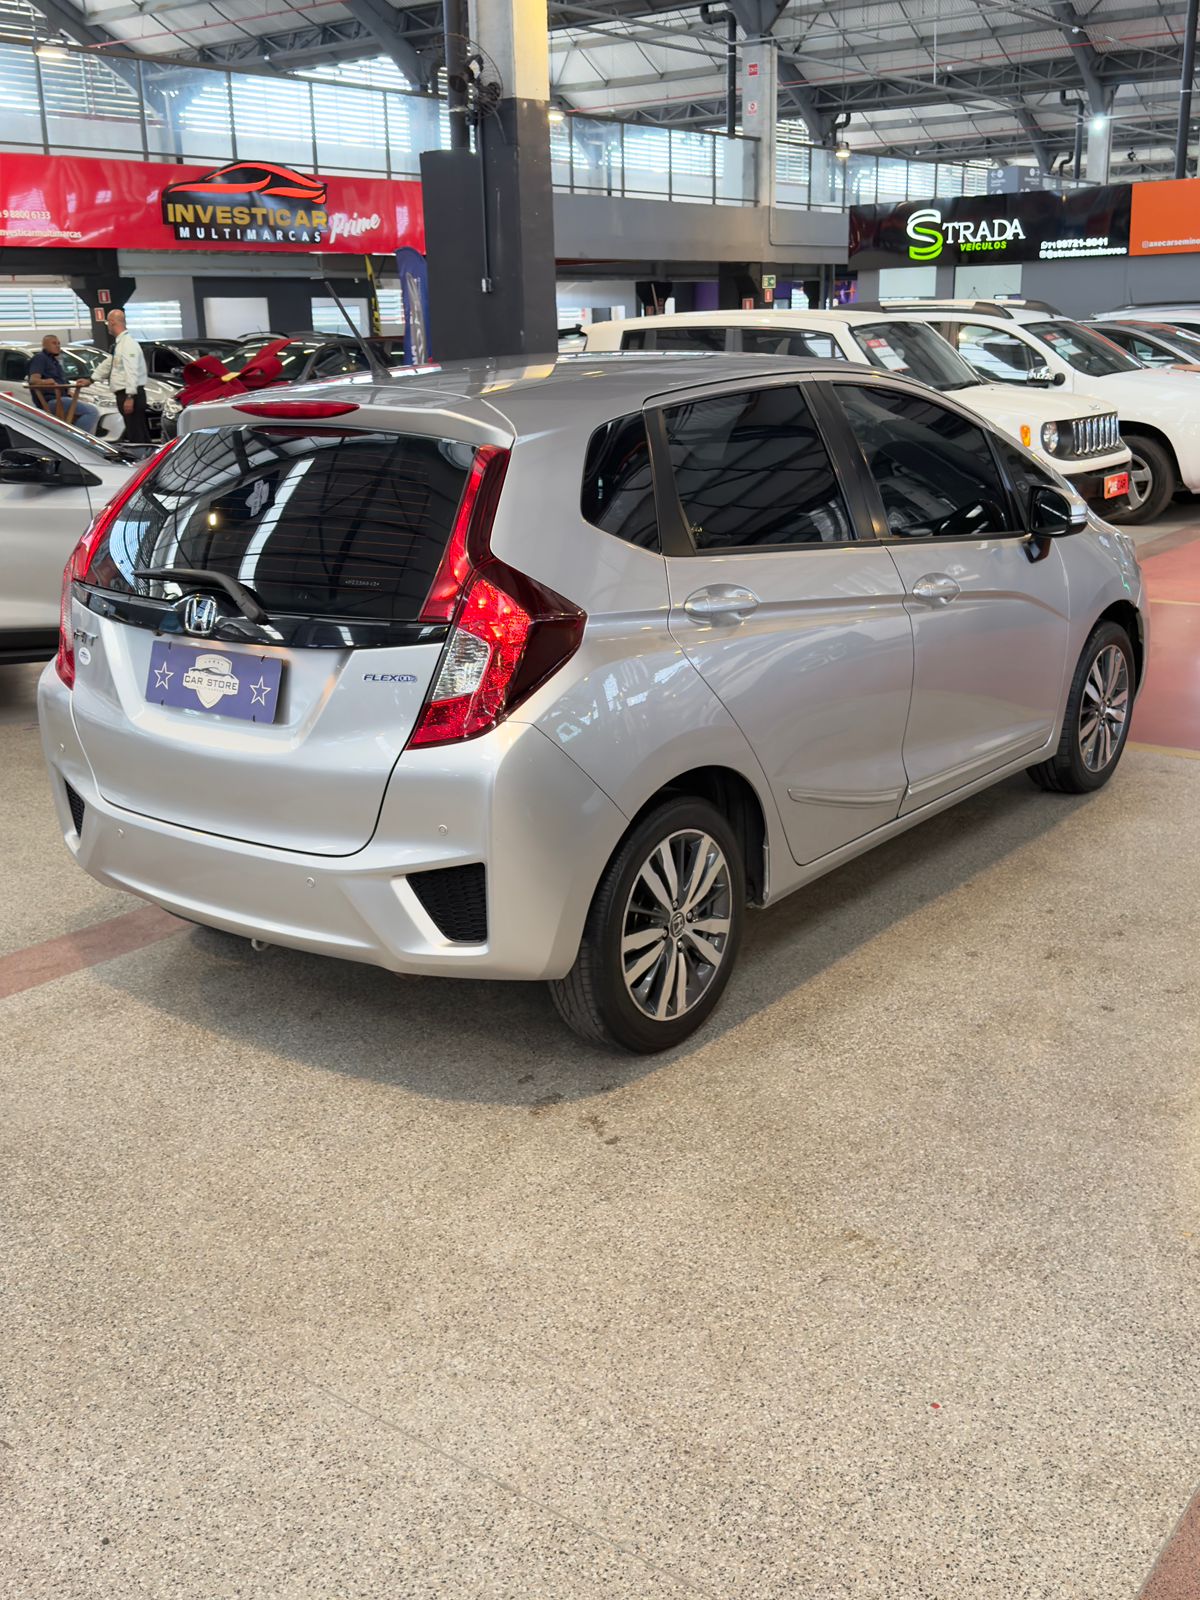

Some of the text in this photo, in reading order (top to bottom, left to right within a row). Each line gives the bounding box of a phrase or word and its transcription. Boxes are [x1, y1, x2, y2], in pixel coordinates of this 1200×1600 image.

[167, 203, 328, 228] INVESTICAR
[179, 226, 321, 243] MULTIMARCAS
[329, 212, 381, 244] Prime
[906, 208, 1026, 260] STRADA
[960, 240, 1007, 252] VEÍCULOS
[184, 674, 204, 686] CAR
[207, 677, 238, 691] STORE
